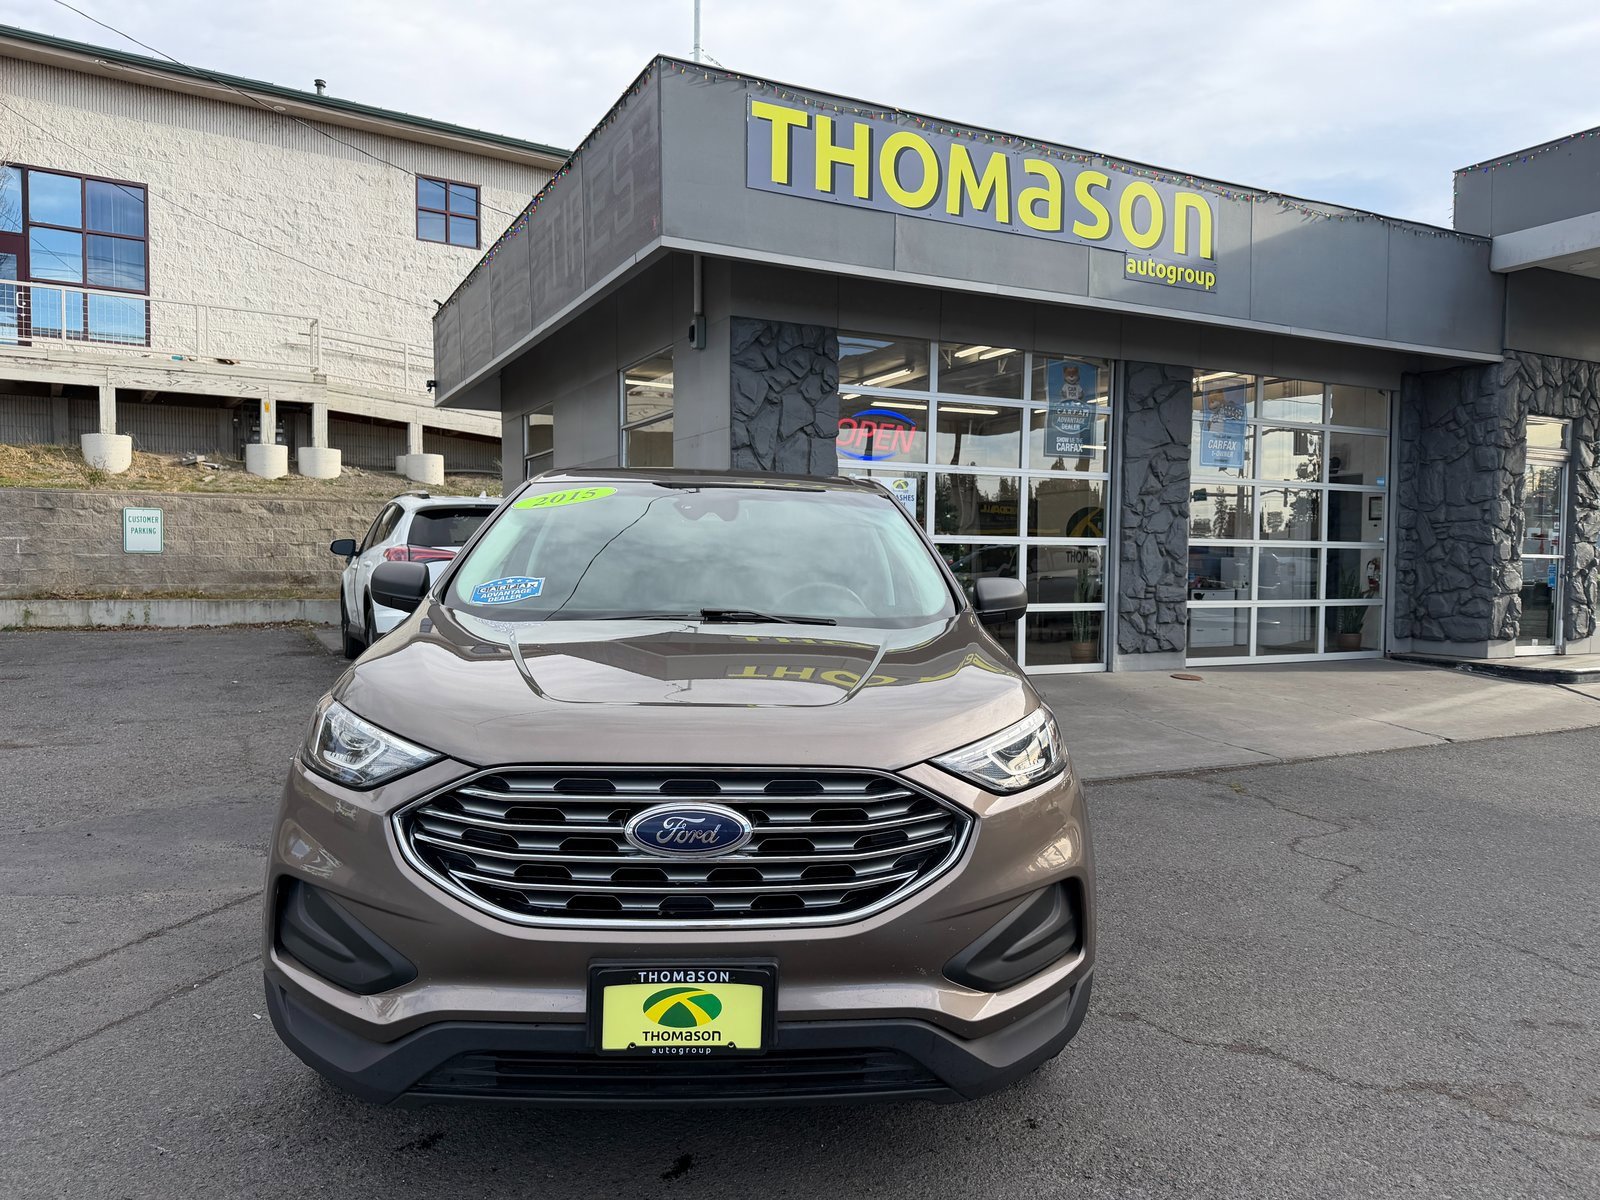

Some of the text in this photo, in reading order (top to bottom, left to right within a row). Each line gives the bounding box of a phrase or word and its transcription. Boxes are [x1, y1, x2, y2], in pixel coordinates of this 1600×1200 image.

[1126, 258, 1216, 290] autogroup
[1057, 416, 1085, 424] ADVANTAGE
[836, 418, 916, 454] OPEN
[1056, 443, 1083, 453] CARFAX
[1208, 440, 1237, 450] CARFAX
[532, 488, 599, 507] 2015
[130, 527, 157, 535] PARKING
[481, 588, 532, 599] ADVANTAGE
[487, 594, 522, 602] DEALER
[656, 816, 721, 844] Ford
[651, 1046, 712, 1055] autogroup
